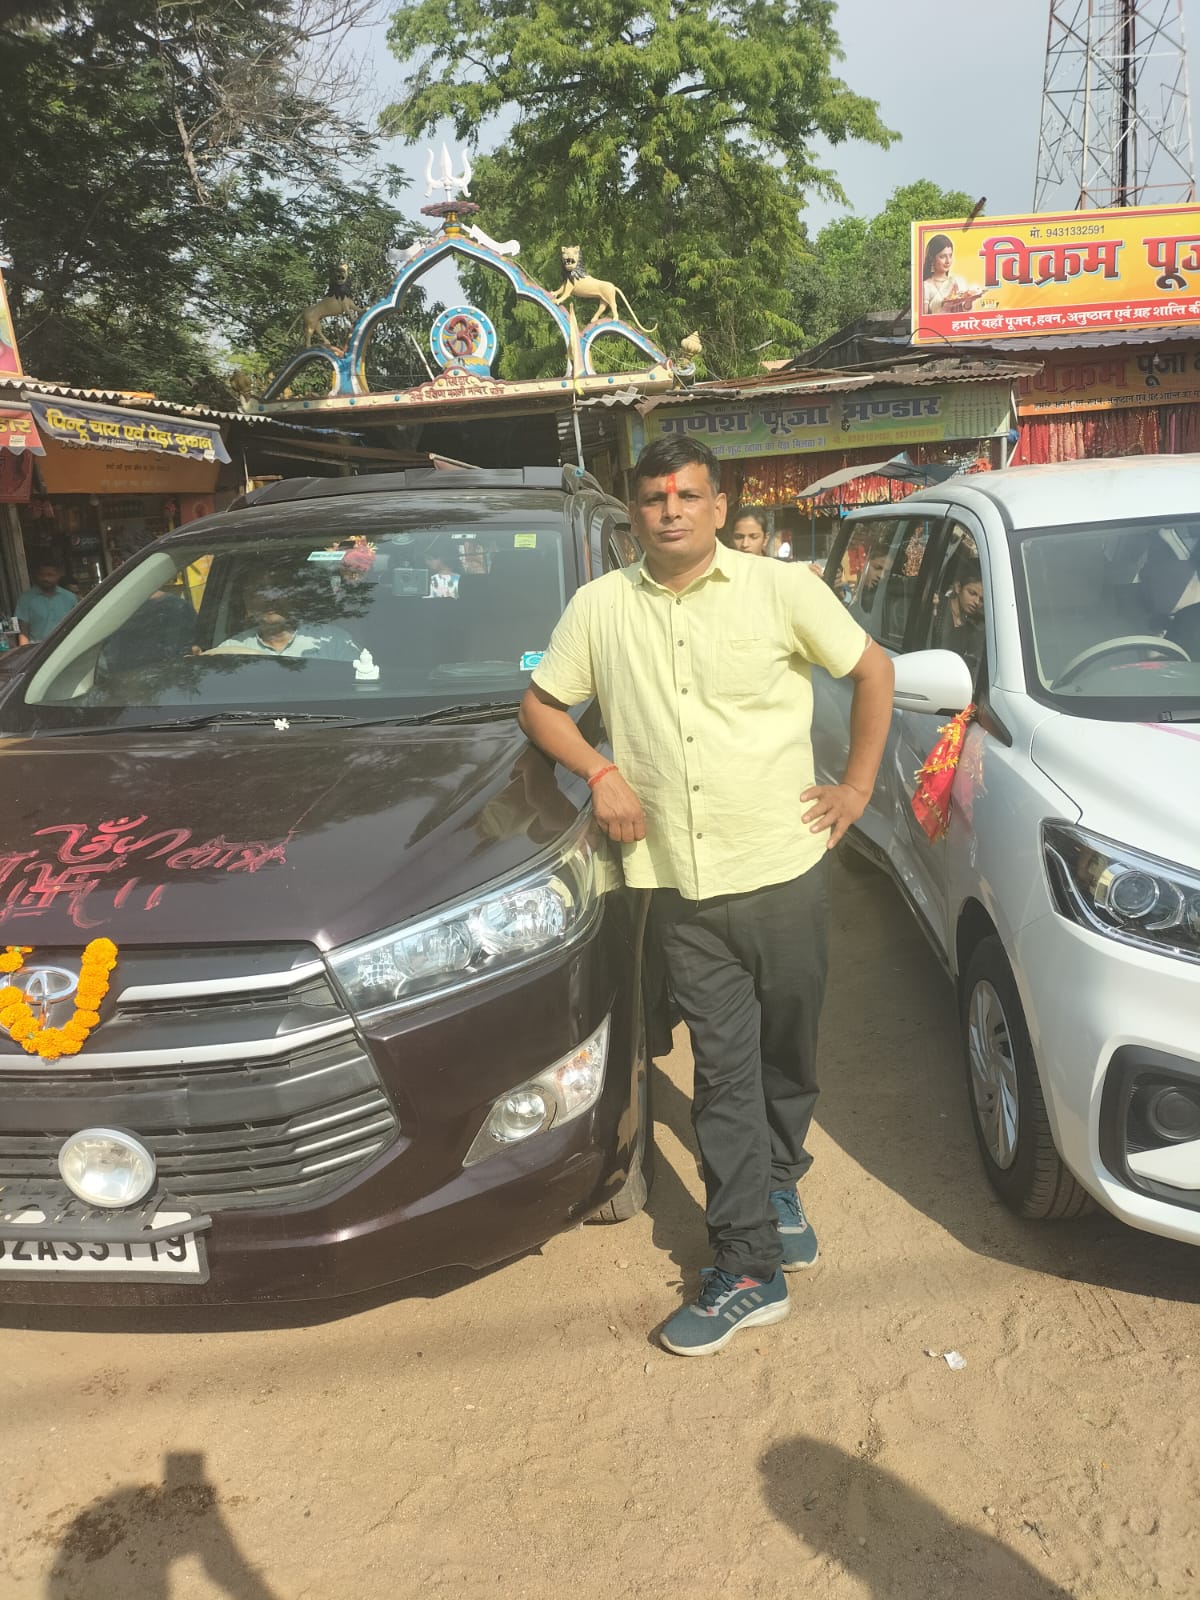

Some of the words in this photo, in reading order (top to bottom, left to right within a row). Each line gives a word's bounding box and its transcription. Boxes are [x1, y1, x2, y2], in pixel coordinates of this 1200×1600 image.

[1046, 225, 1106, 238] 9431332591
[979, 236, 1124, 288] विक्रम
[951, 316, 981, 332] हमारे
[981, 312, 1004, 330] यहाँ
[1066, 309, 1113, 325] अनुष्ठान
[1114, 306, 1132, 322] एवं
[1133, 307, 1152, 319] ग्रह
[1153, 301, 1188, 316] शान्ति
[46, 408, 91, 443] पिन्टू
[88, 420, 121, 438] चाय
[123, 423, 145, 442] एवं
[174, 432, 214, 454] दुकान
[658, 410, 750, 434] गणेश
[760, 405, 832, 435] पूजा
